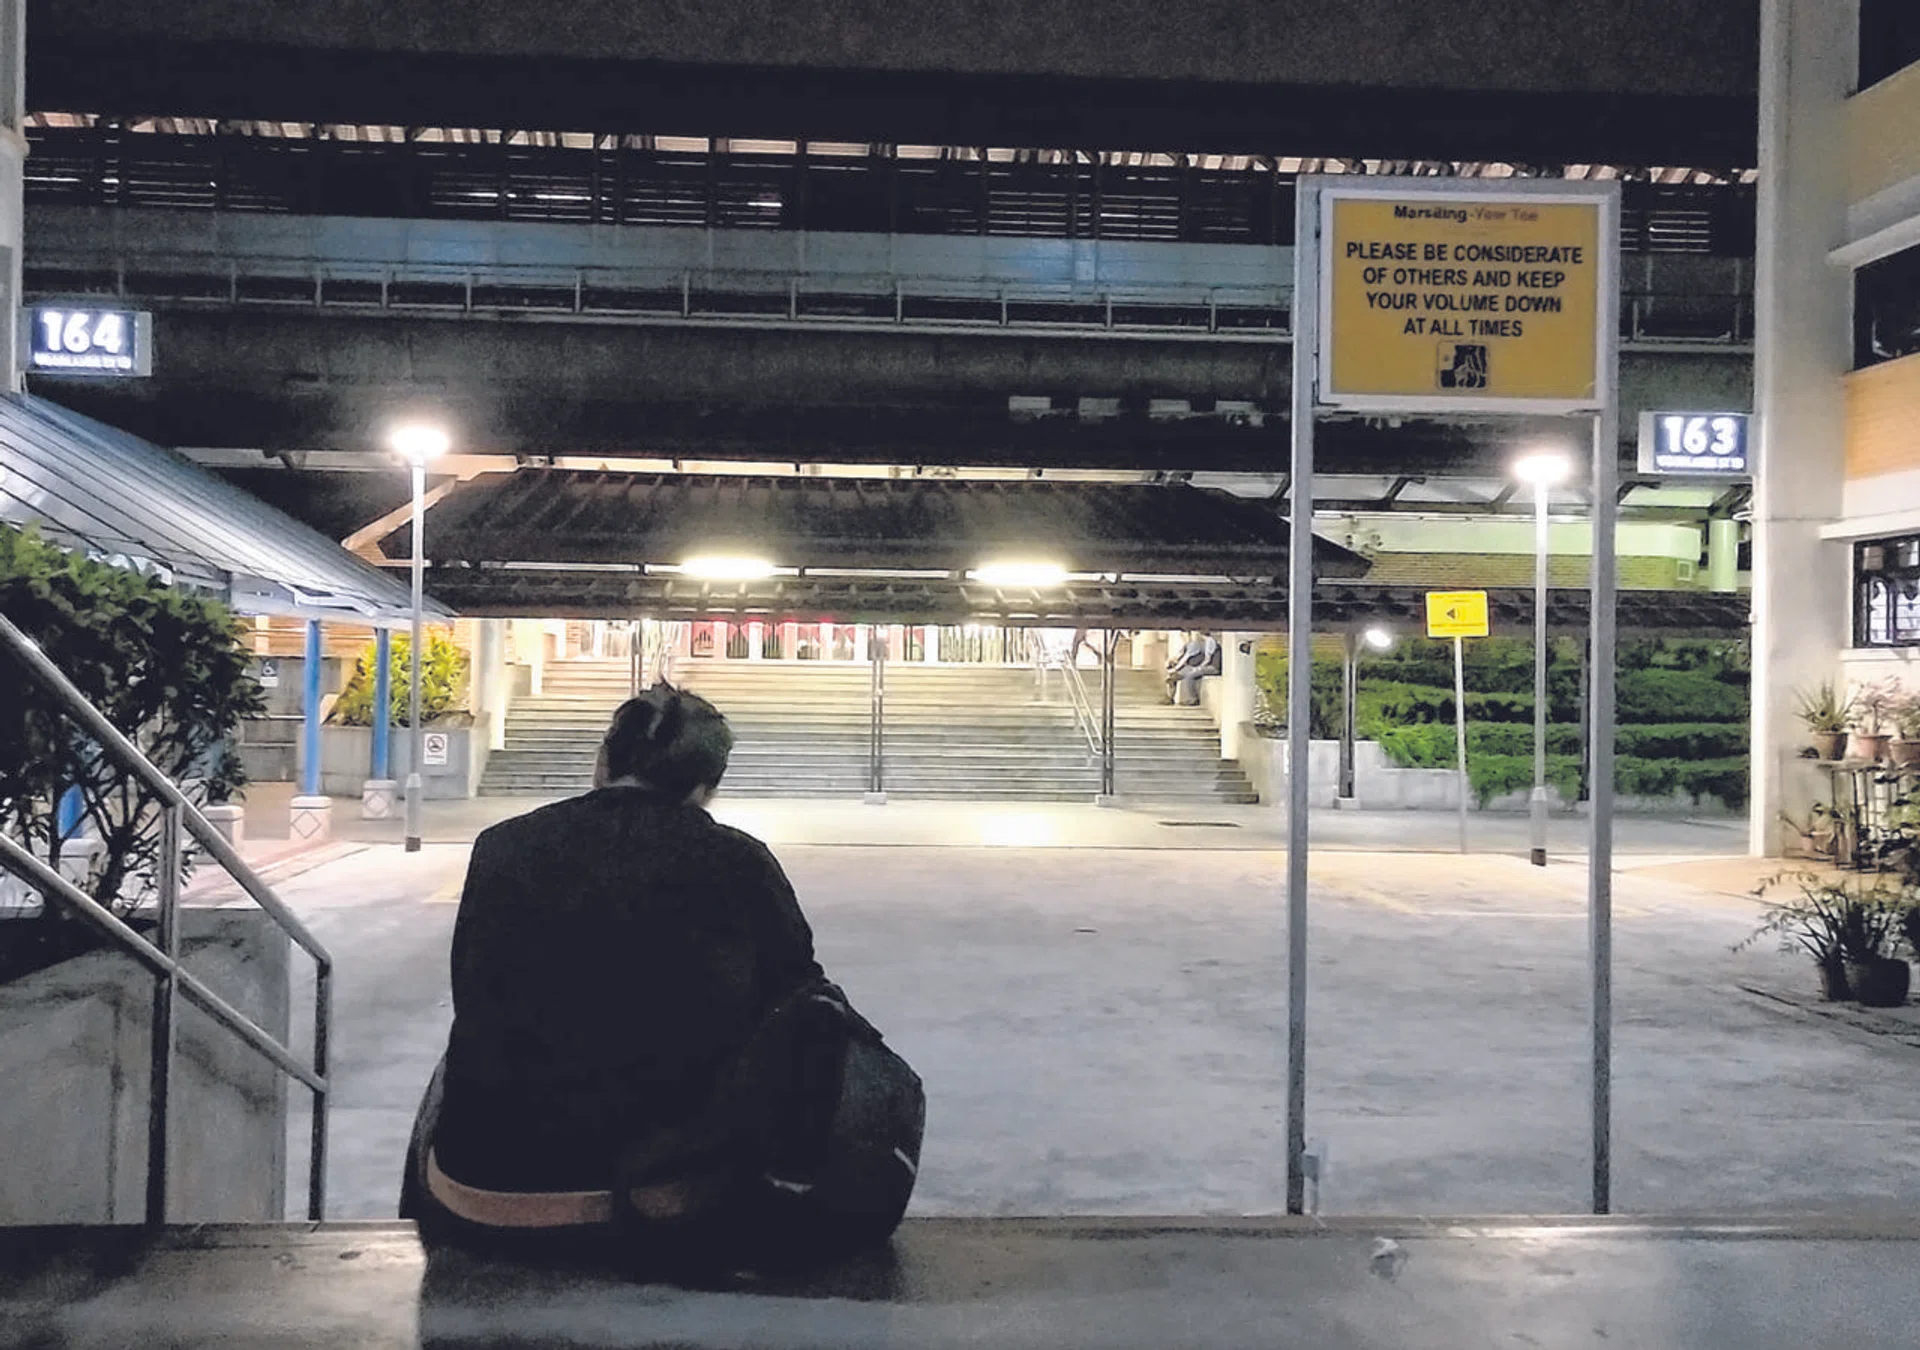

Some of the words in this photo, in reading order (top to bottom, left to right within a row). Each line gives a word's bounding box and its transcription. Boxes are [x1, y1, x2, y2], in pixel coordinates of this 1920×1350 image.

[1346, 241, 1417, 260] PLEASE
[1424, 243, 1448, 261] BE
[1454, 244, 1583, 264] CONSIDERATE
[1363, 267, 1388, 285] OF
[1393, 268, 1468, 286] OTHERS
[1472, 270, 1511, 287] AND
[1517, 271, 1566, 289] KEEP
[1366, 291, 1417, 310] YOUR
[1423, 293, 1499, 312] VOLUME
[1505, 295, 1562, 313] DOWN
[42, 311, 122, 353] 164
[1403, 317, 1426, 335] AT
[1429, 318, 1464, 336] ALL
[1469, 319, 1523, 337] TIMES
[1664, 415, 1737, 455] 163
